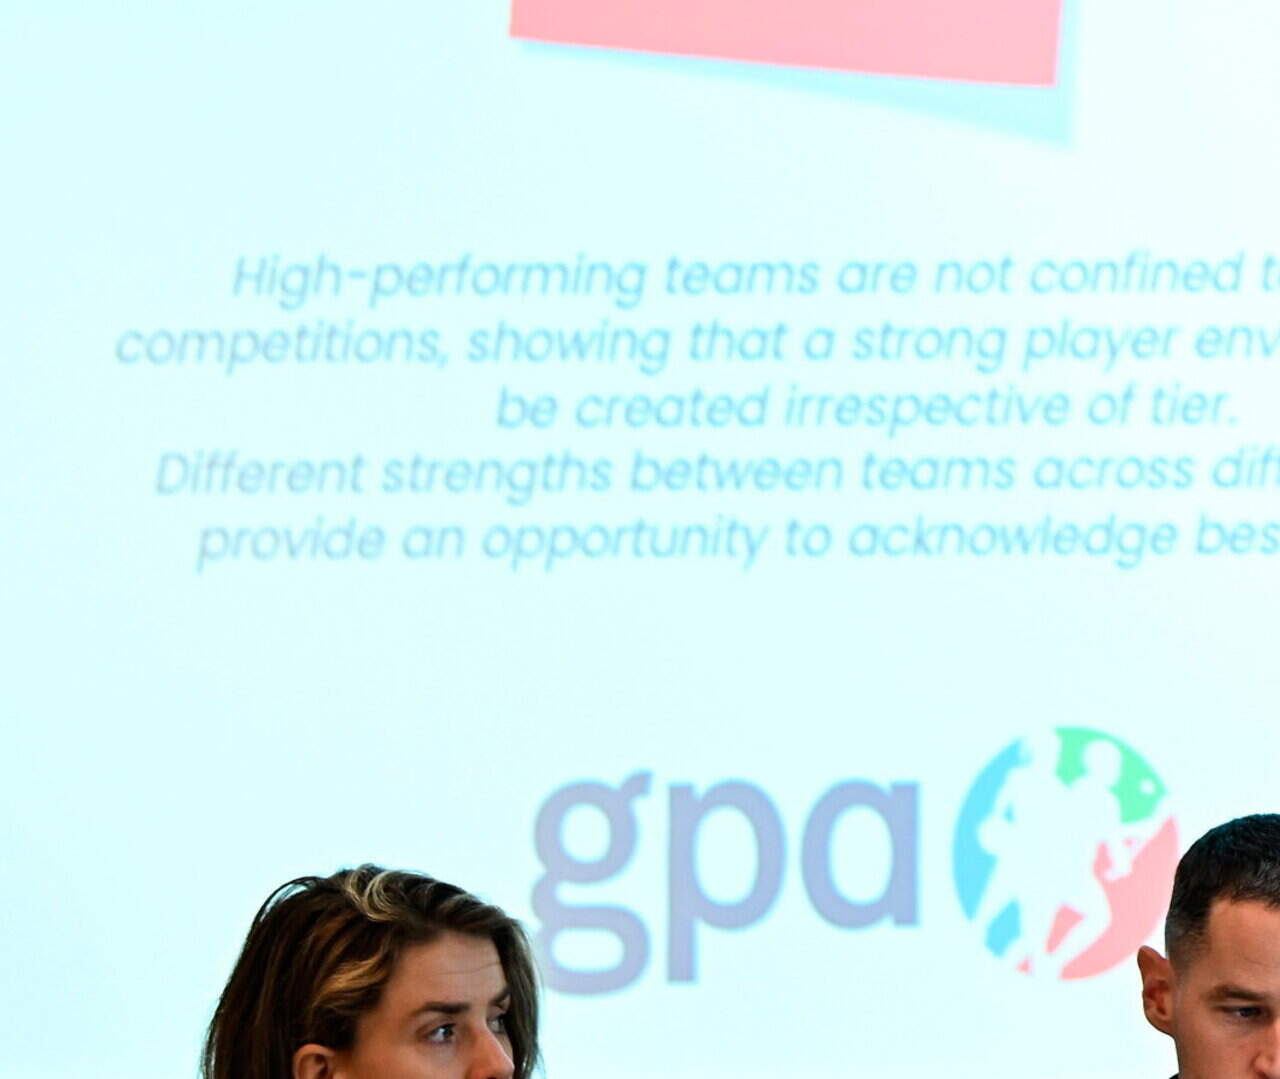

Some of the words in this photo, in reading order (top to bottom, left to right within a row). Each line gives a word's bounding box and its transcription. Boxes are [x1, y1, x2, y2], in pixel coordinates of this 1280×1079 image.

[233, 253, 648, 312] High-performing
[665, 256, 820, 296] teams
[837, 261, 918, 294] are
[934, 256, 1014, 294] not
[1029, 250, 1244, 294] confined
[115, 320, 448, 376] competitions,
[466, 318, 672, 376] showing
[689, 320, 789, 361] that
[803, 328, 836, 360] a
[852, 320, 1008, 374] strong
[1022, 319, 1179, 372] player
[496, 386, 559, 429] be
[575, 386, 770, 428] created
[785, 384, 1071, 439] irrespective
[1087, 382, 1136, 426] of
[1152, 384, 1236, 425] tier.
[156, 449, 367, 496] Different
[381, 449, 613, 507] strengths
[630, 450, 843, 492] between
[862, 452, 1015, 491] teams
[1033, 456, 1194, 490] across
[195, 515, 387, 574] provide
[401, 525, 465, 560] an
[481, 515, 770, 572] opportunity
[785, 518, 832, 557] to
[848, 514, 1179, 570] acknowledge
[528, 768, 922, 998] gpa
